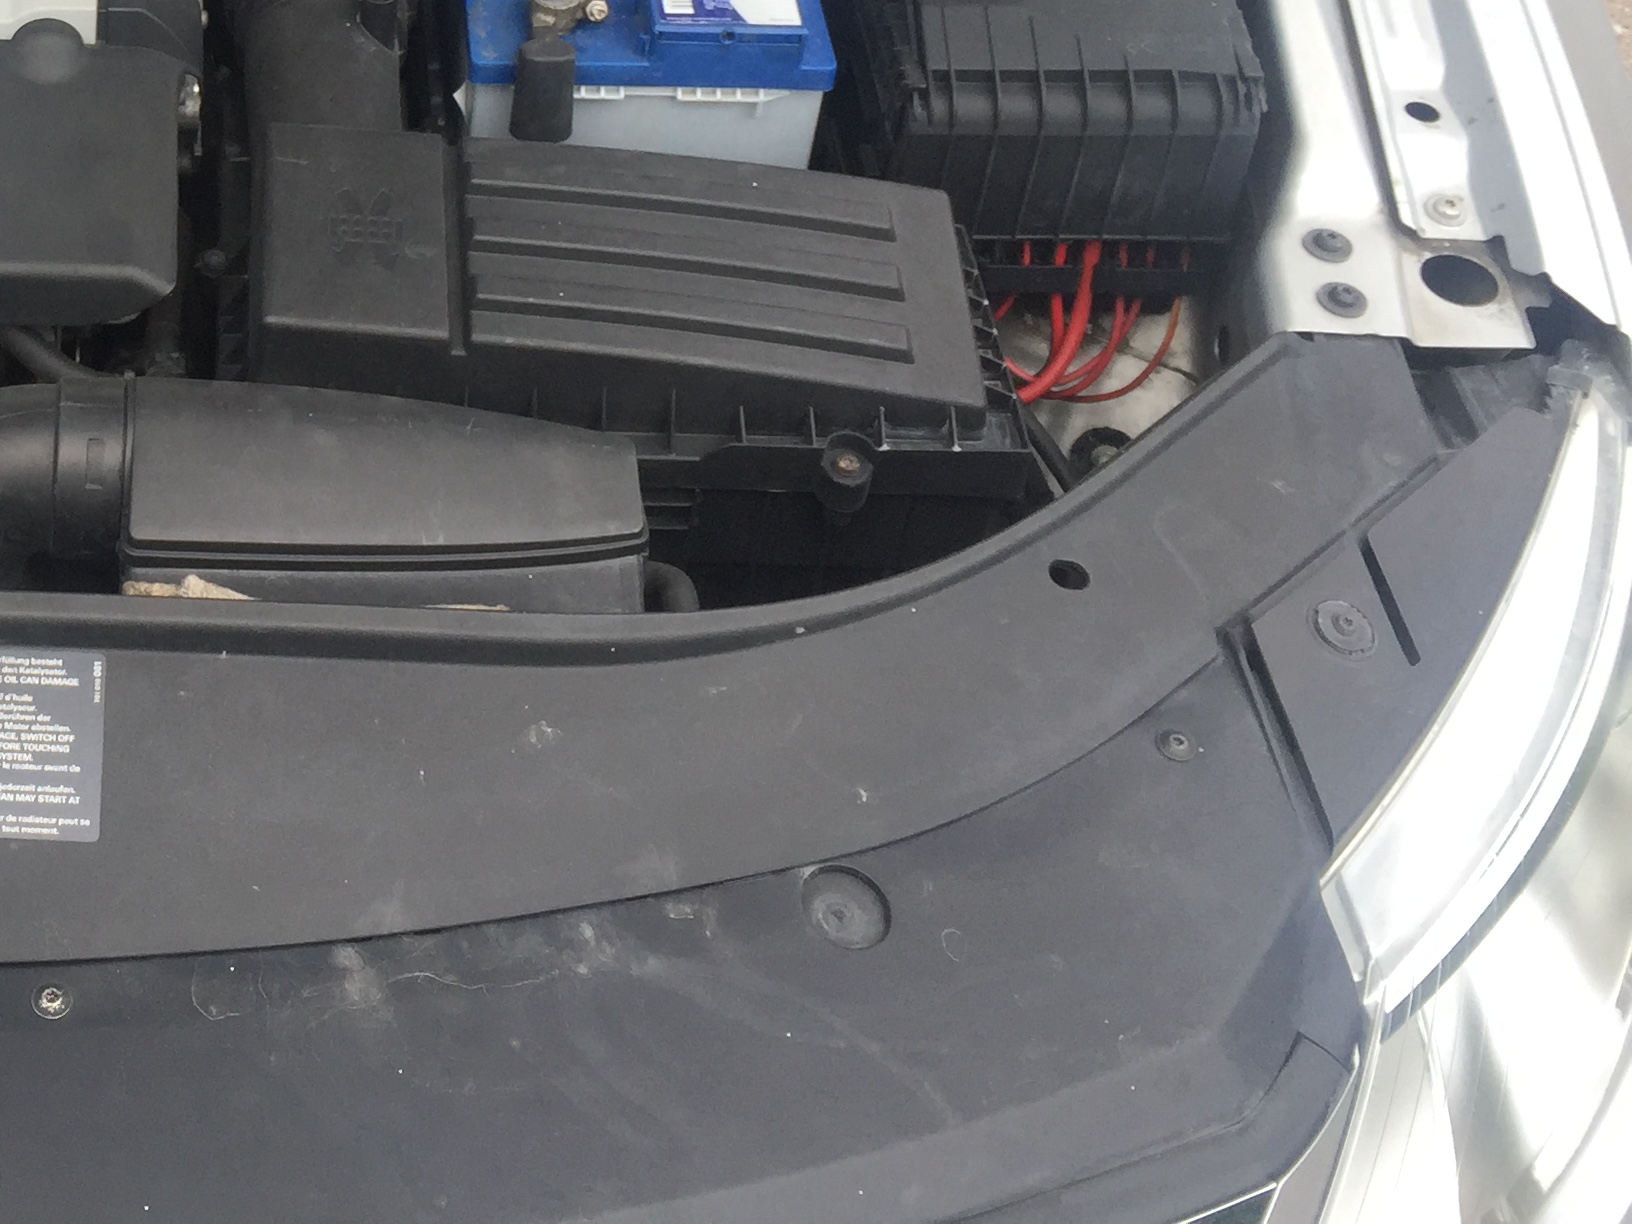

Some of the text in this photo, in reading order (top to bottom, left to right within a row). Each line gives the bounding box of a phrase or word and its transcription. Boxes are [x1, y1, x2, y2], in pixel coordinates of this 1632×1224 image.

[4, 675, 19, 684] OIL
[20, 676, 39, 684] CAN
[40, 677, 80, 686] DAMAGE
[21, 733, 57, 742] SWITCH
[58, 734, 75, 742] OFF
[24, 743, 70, 753] TOUCHING
[12, 762, 42, 770] moteur
[44, 763, 68, 771] avant
[16, 793, 36, 802] MAY
[38, 795, 67, 803] START
[18, 815, 57, 824] radiateur
[59, 817, 78, 827] peut
[2, 824, 20, 832] tout
